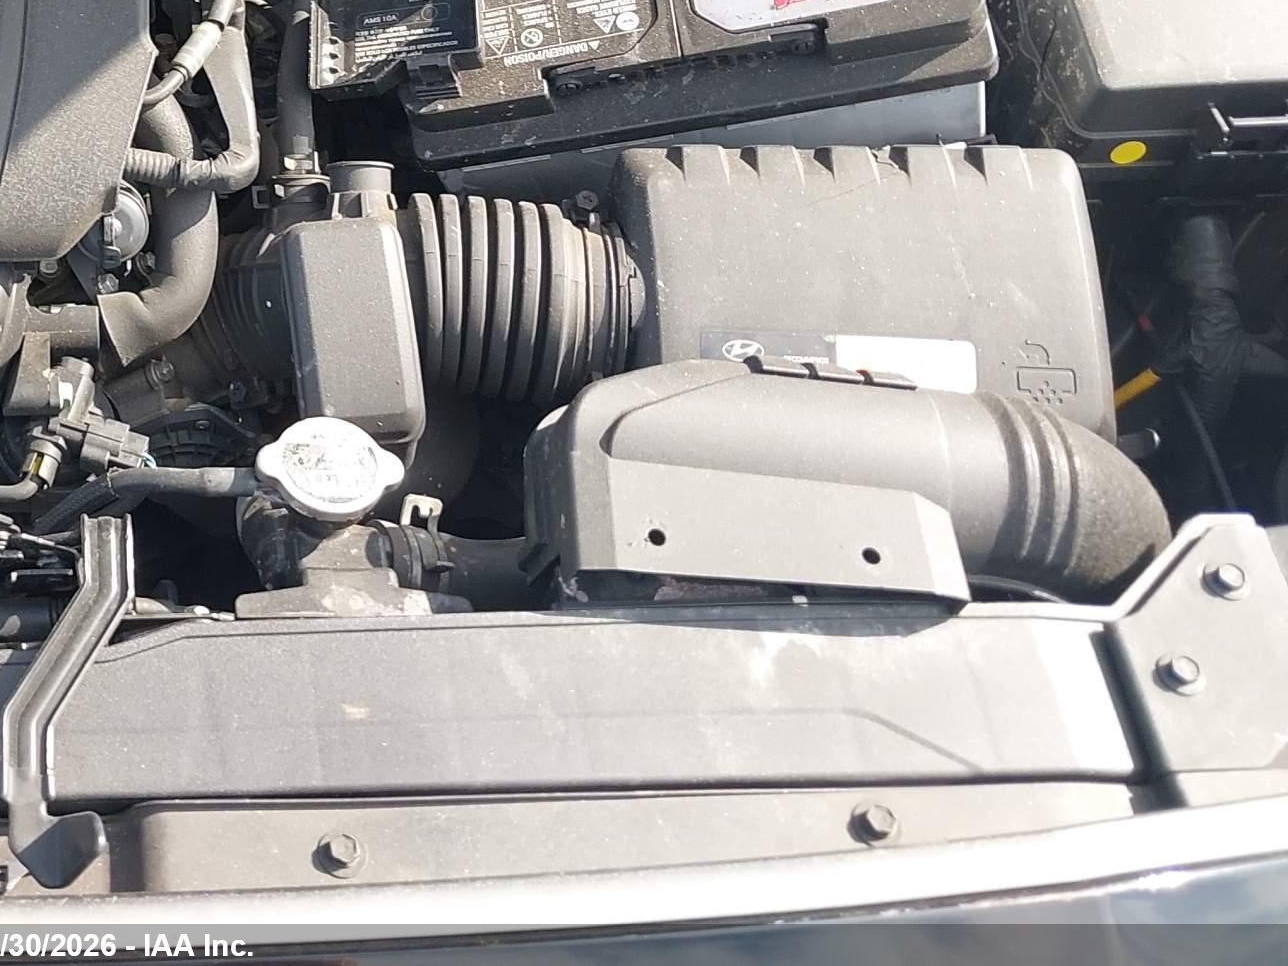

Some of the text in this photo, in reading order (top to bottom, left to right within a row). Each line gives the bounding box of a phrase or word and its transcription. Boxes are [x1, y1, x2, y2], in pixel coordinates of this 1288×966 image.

[363, 14, 399, 25] AMS 10A
[504, 42, 589, 66] DANGER/POISON
